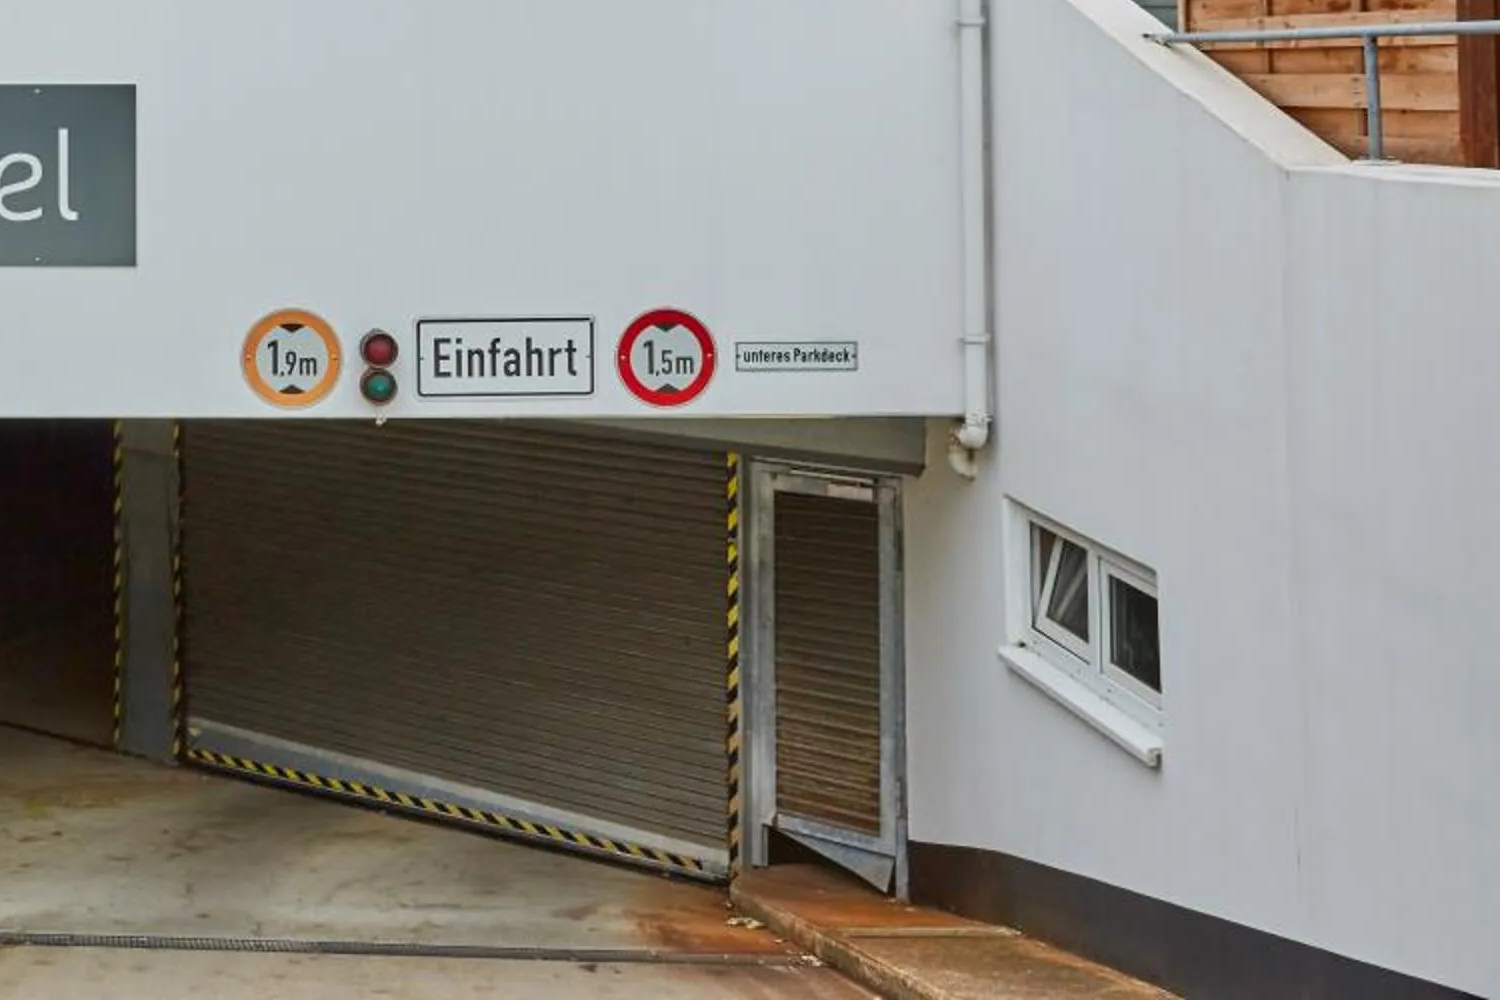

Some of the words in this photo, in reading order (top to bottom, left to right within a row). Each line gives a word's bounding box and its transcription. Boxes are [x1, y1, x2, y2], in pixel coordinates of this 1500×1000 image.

[433, 337, 578, 378] Einfahrt
[743, 350, 791, 363] unteres
[793, 348, 850, 363] Parkdeck
